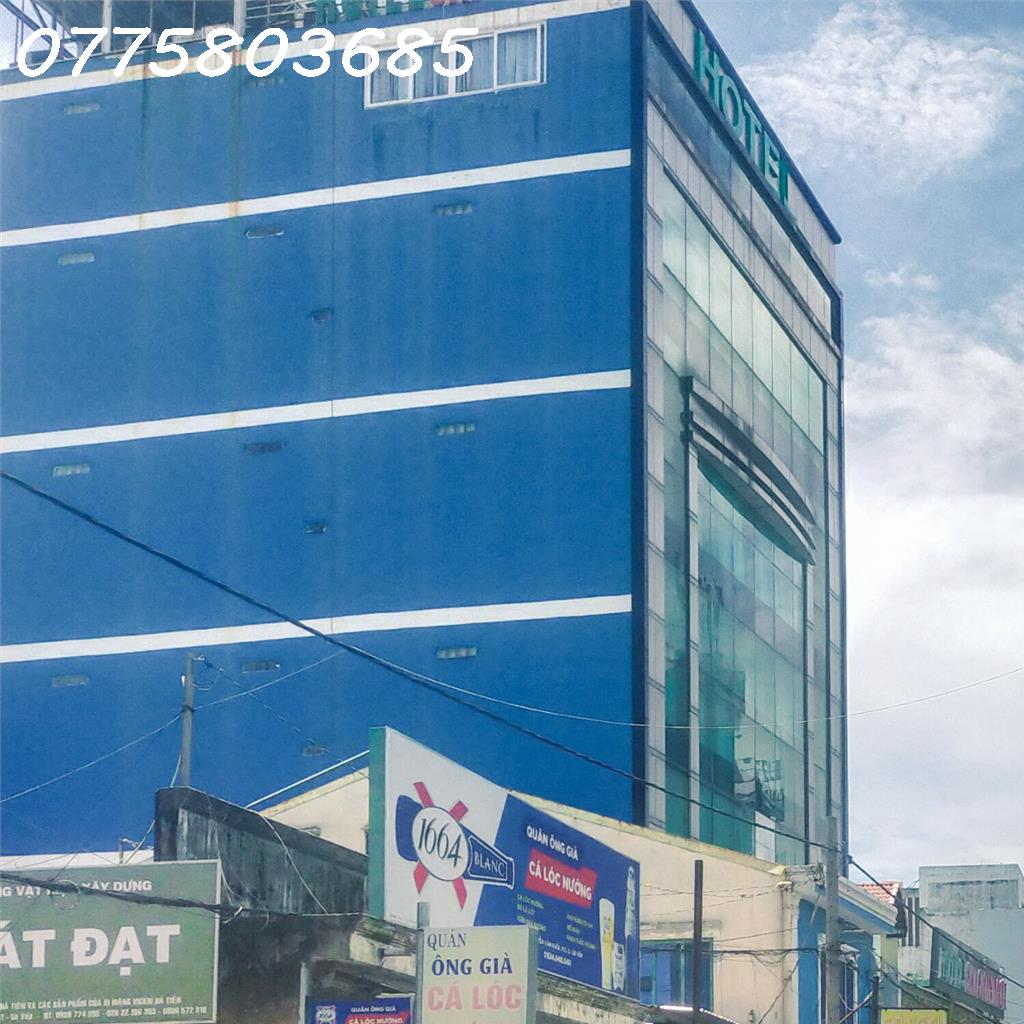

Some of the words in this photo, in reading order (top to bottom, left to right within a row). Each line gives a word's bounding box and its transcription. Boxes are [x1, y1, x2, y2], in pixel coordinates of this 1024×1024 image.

[693, 29, 791, 213] HOTEL
[417, 817, 463, 868] 1664
[526, 826, 550, 848] QUÁN
[550, 833, 566, 854] ÔNG
[473, 851, 506, 877] BLANC
[543, 864, 561, 888] LÓC
[562, 873, 592, 901] NƯỚNG
[70, 924, 181, 976] ĐẠT
[427, 930, 467, 950] QUÁN
[431, 954, 472, 976] ÔNG
[479, 953, 513, 975] GIÀ
[427, 980, 463, 1011] CÁ
[471, 979, 522, 1010] LÓC
